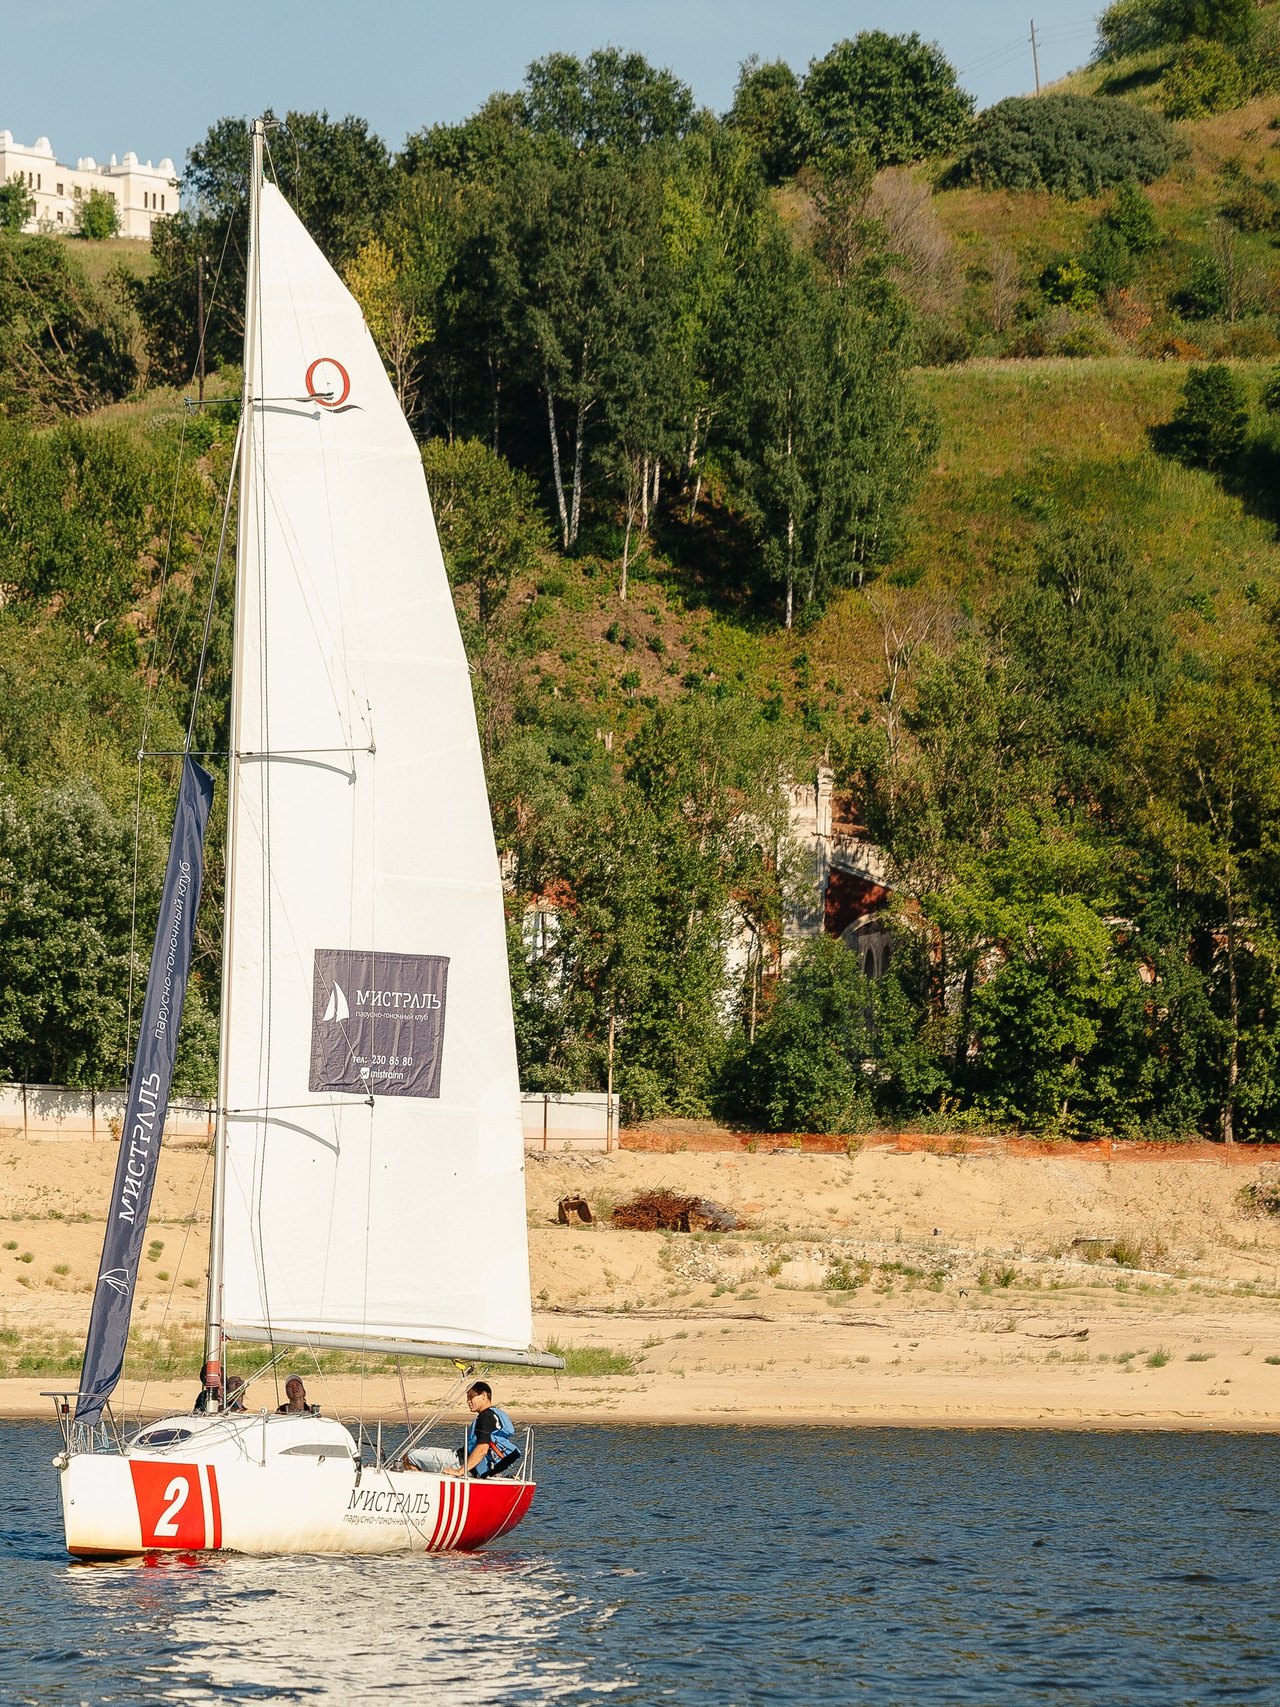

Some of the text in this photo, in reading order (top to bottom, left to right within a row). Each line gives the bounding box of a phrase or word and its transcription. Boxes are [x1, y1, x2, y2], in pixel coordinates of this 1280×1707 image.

[154, 860, 191, 1040] парусно-гоночный клуб
[355, 990, 442, 1009] МИСТРАЛЬ
[371, 1055, 386, 1065] 230
[389, 1056, 400, 1066] 85
[402, 1056, 413, 1067] 80
[118, 1072, 161, 1226] МИСТРАЛЬ
[152, 1476, 190, 1537] 2
[347, 1489, 431, 1514] МИСТРАЛЬ
